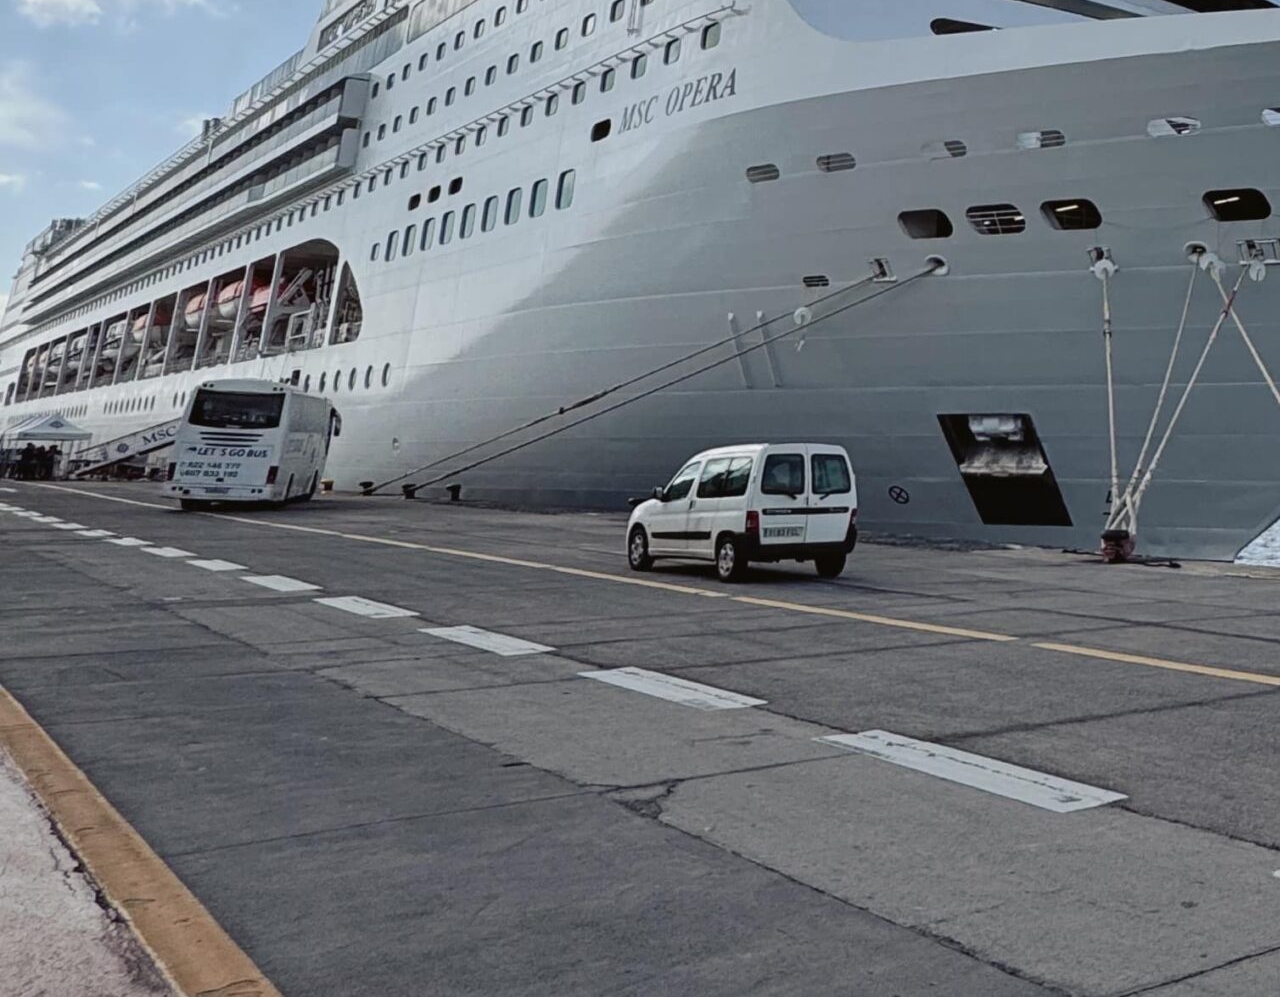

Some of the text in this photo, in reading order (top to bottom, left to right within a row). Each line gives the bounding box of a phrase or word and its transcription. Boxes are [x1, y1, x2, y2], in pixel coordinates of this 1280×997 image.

[618, 67, 736, 135] MSC OPERA
[142, 425, 177, 446] MSC
[229, 448, 246, 458] GO
[246, 449, 268, 459] BUS
